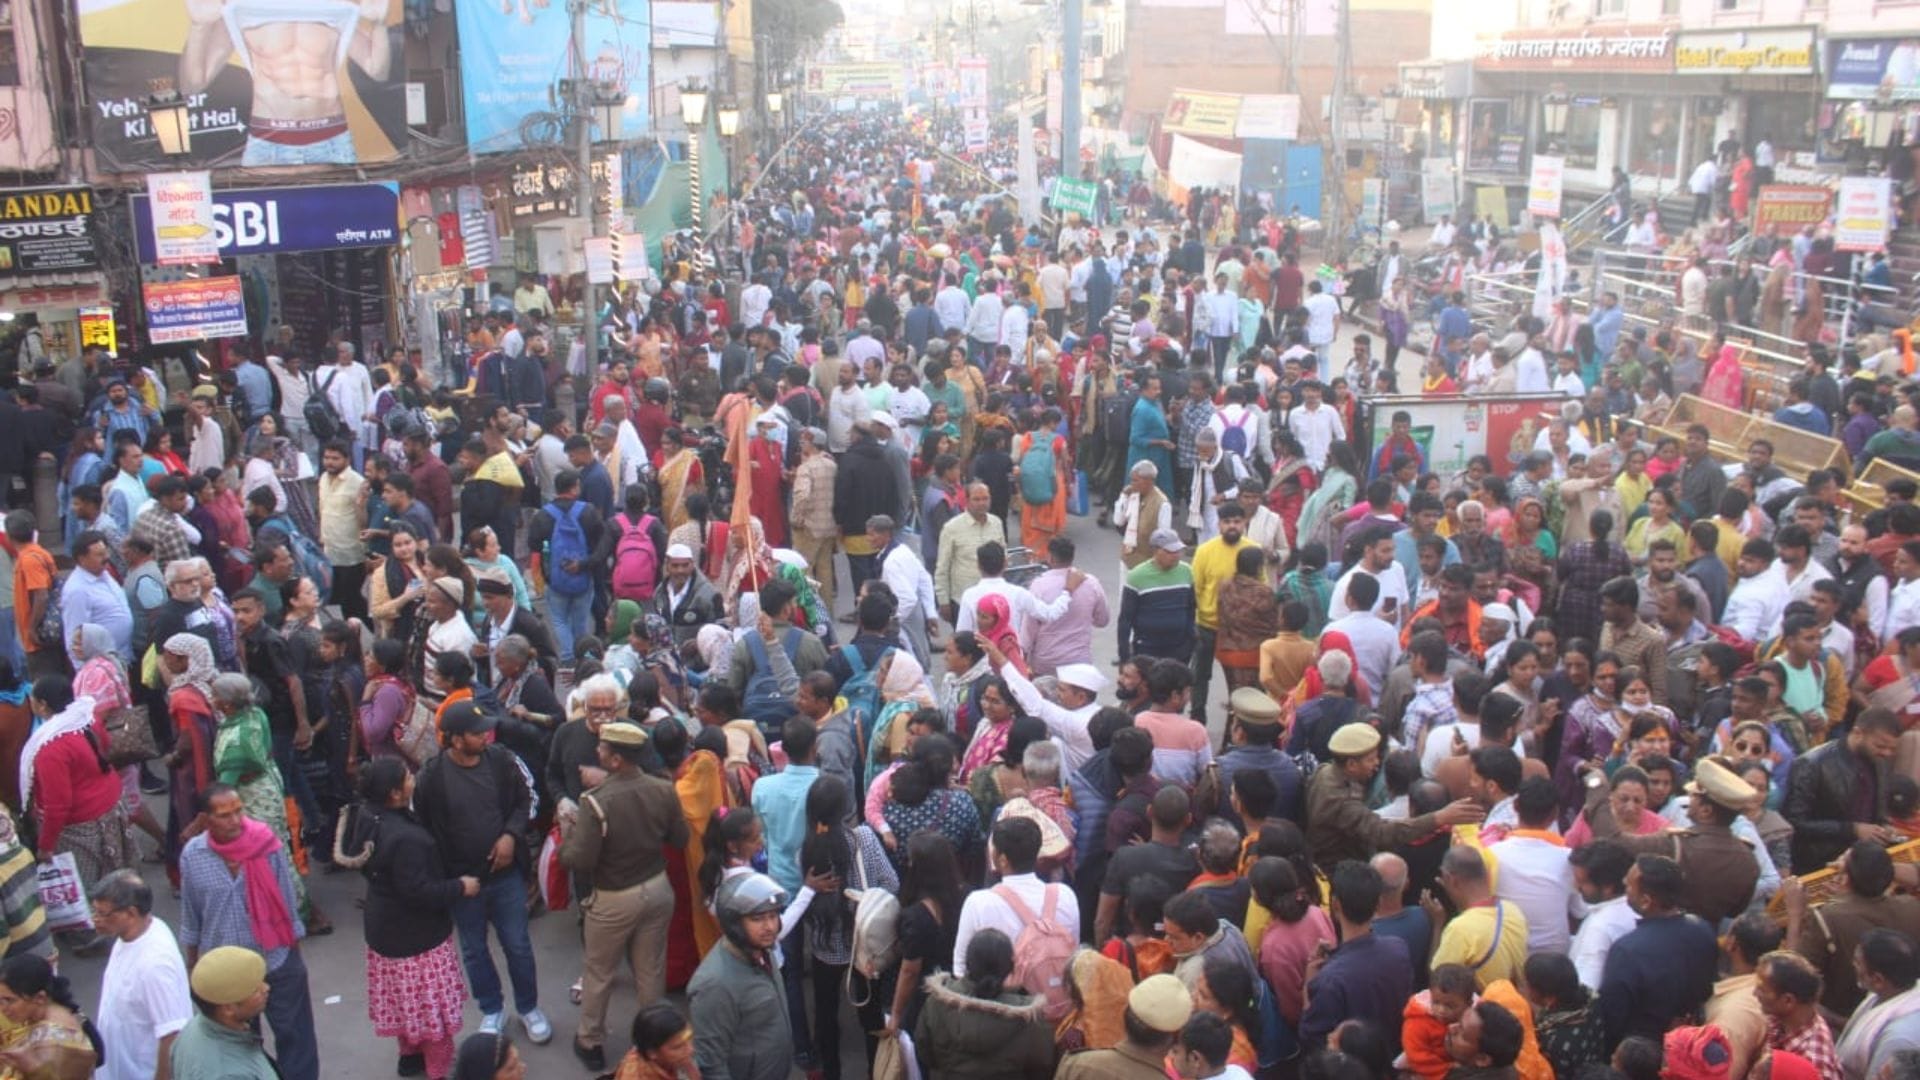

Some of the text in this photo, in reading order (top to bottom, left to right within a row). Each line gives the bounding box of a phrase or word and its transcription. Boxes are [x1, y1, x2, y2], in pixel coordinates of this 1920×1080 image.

[98, 97, 139, 118] Yeh
[124, 118, 146, 138] Ki
[202, 107, 238, 128] Hai
[0, 191, 92, 218] ANDAI
[1762, 203, 1826, 222] TRAVELS
[212, 200, 280, 248] SBI
[370, 229, 392, 240] ATM
[1491, 403, 1520, 415] STOP
